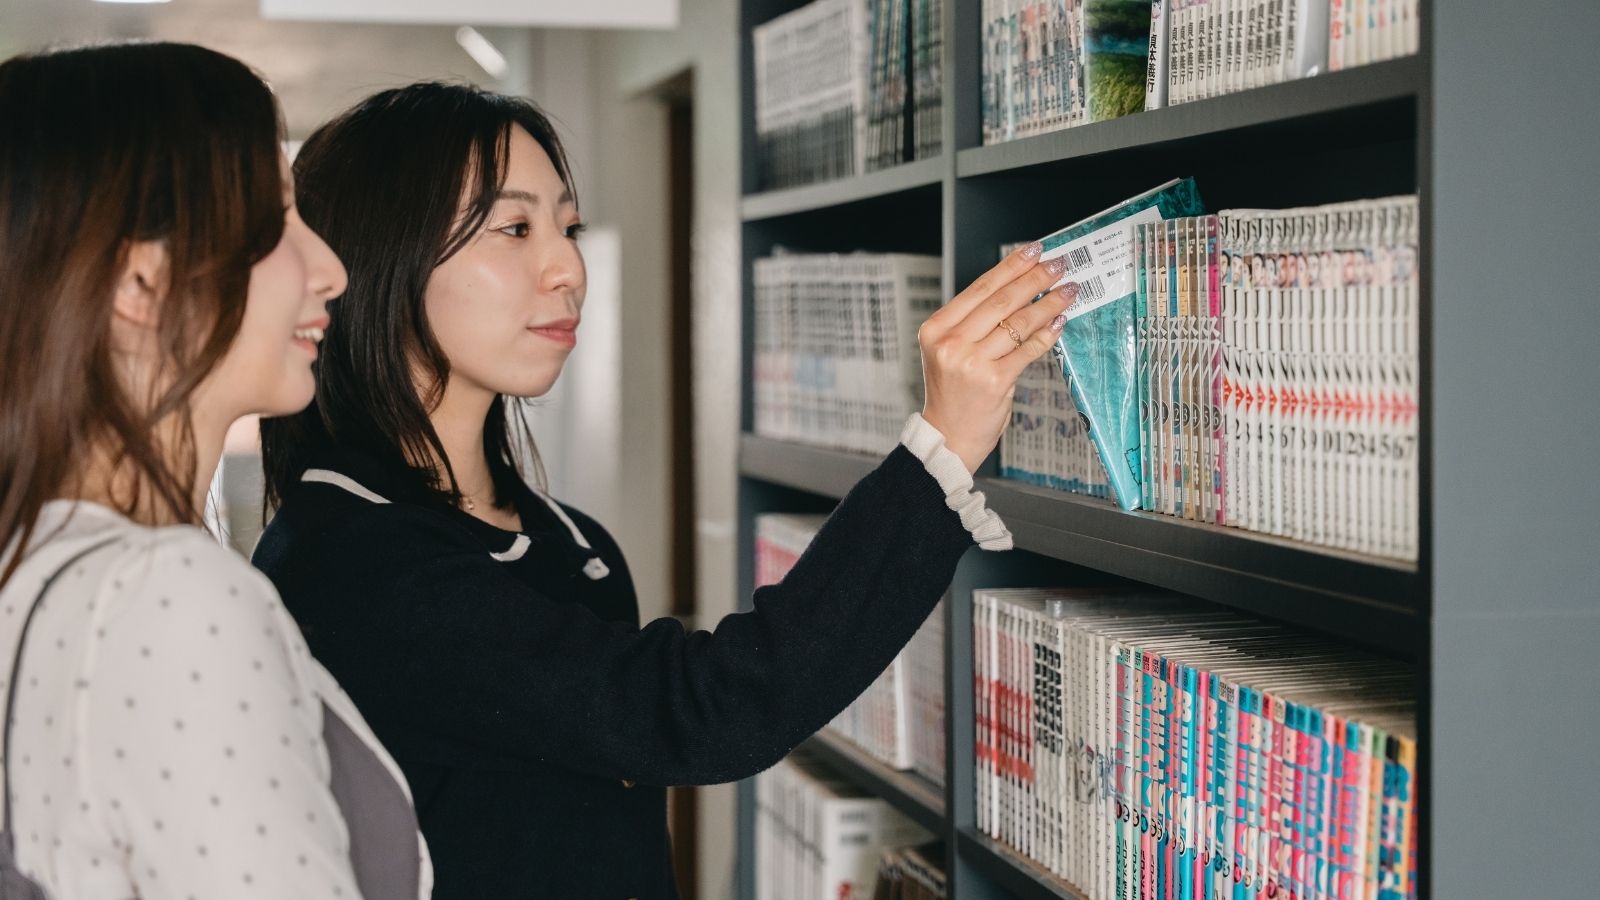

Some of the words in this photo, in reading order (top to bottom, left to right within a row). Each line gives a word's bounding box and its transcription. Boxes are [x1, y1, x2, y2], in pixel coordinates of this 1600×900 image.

[1147, 34, 1158, 93] 貞本義行
[1170, 27, 1178, 85] 貞本義行
[1179, 25, 1187, 84] 貞本義行
[1197, 19, 1206, 80] 貞本義行
